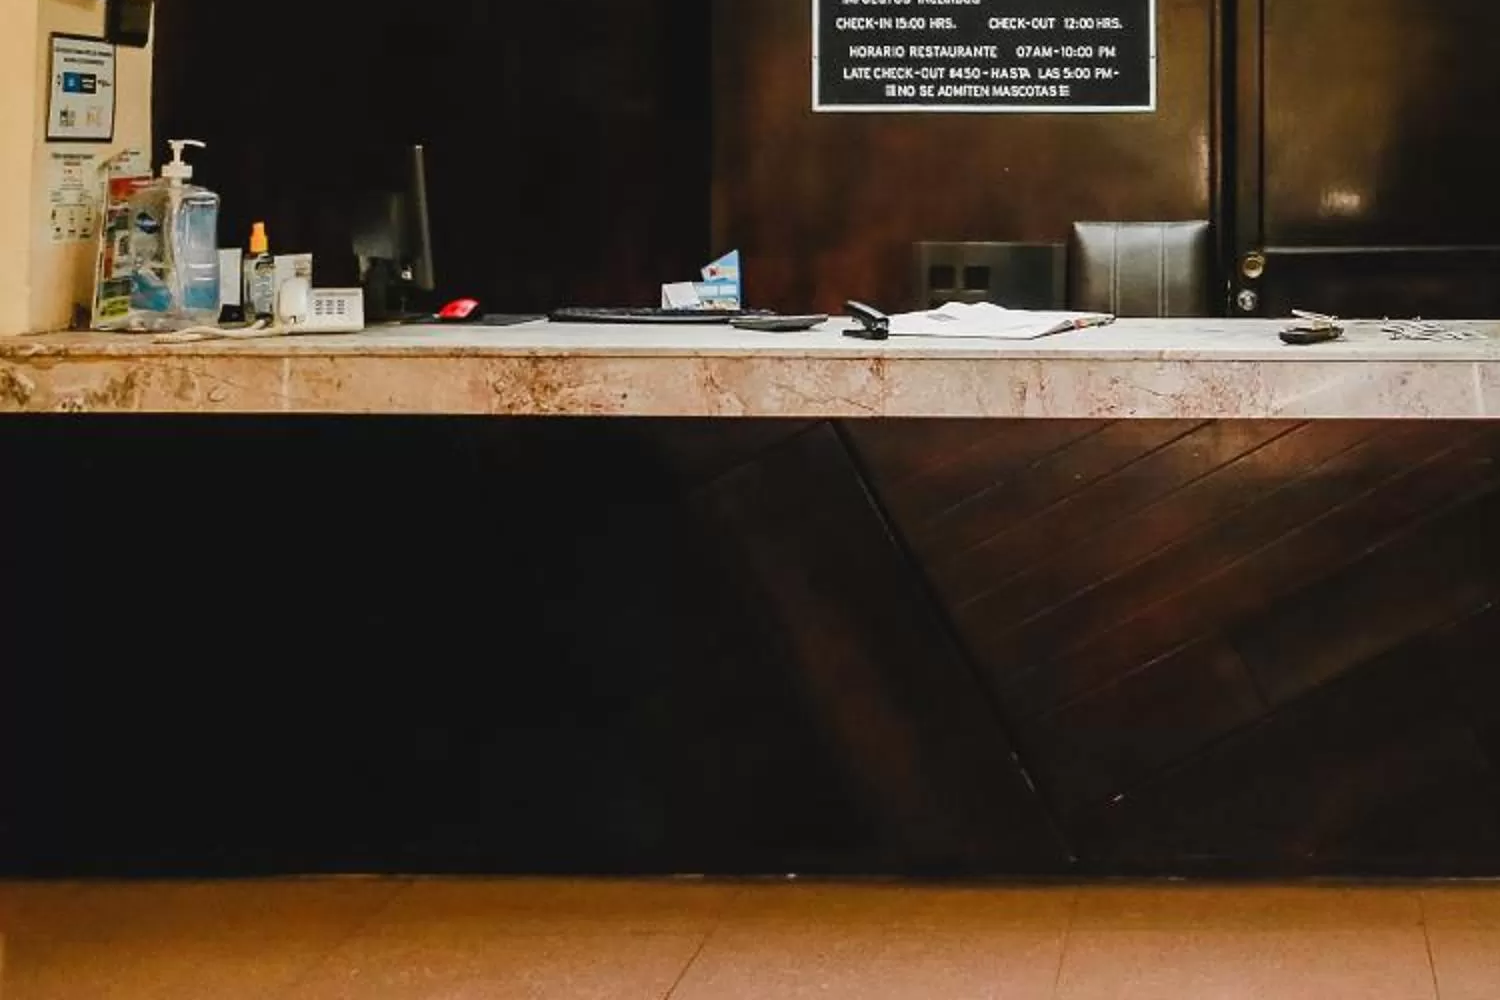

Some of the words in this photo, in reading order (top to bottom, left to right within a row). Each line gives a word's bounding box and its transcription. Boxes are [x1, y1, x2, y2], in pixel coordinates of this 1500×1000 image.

[835, 17, 893, 30] CHECK-IN
[895, 17, 926, 30] 15:00
[929, 17, 957, 30] HRS.
[988, 17, 1056, 30] CHECK-OUT
[1063, 17, 1094, 30] 12:00
[1096, 17, 1123, 30] HRS.
[849, 45, 906, 58] HORARIO
[909, 45, 998, 58] RESTAURANTE
[1098, 45, 1116, 58] PM
[843, 67, 871, 80] LATE
[873, 67, 946, 80] CHECK-OUT
[1037, 67, 1061, 80] LAS
[1062, 67, 1091, 80] 5:00
[919, 84, 935, 97] SE
[937, 84, 990, 97] ADMITEN
